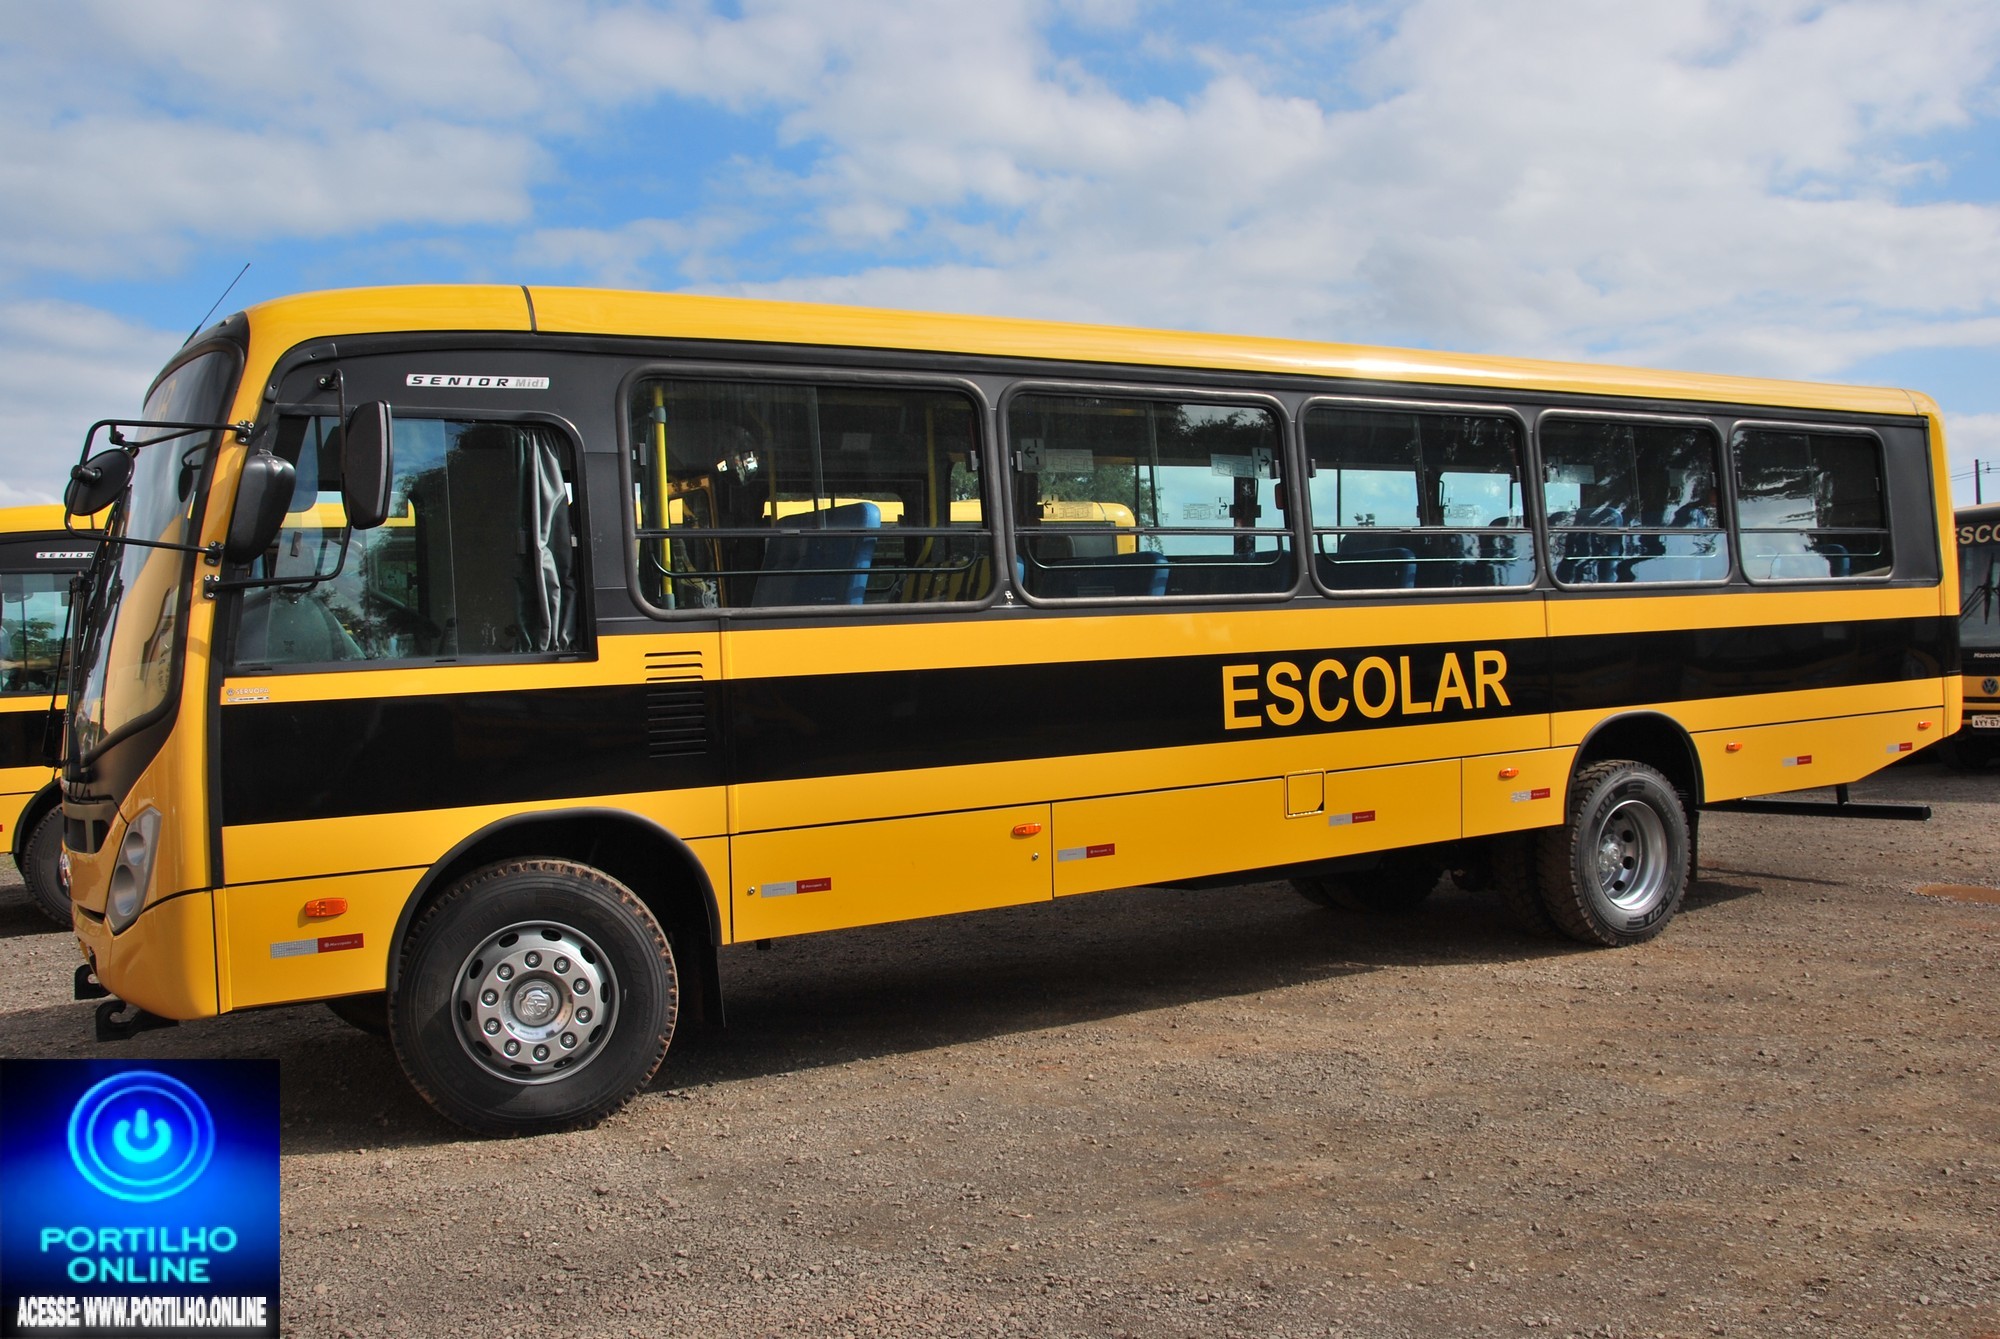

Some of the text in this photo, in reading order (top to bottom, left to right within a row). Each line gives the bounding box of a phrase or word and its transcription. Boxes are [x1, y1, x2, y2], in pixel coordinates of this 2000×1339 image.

[411, 376, 545, 388] SENIOR Midi
[1222, 650, 1511, 730] ESCOLAR
